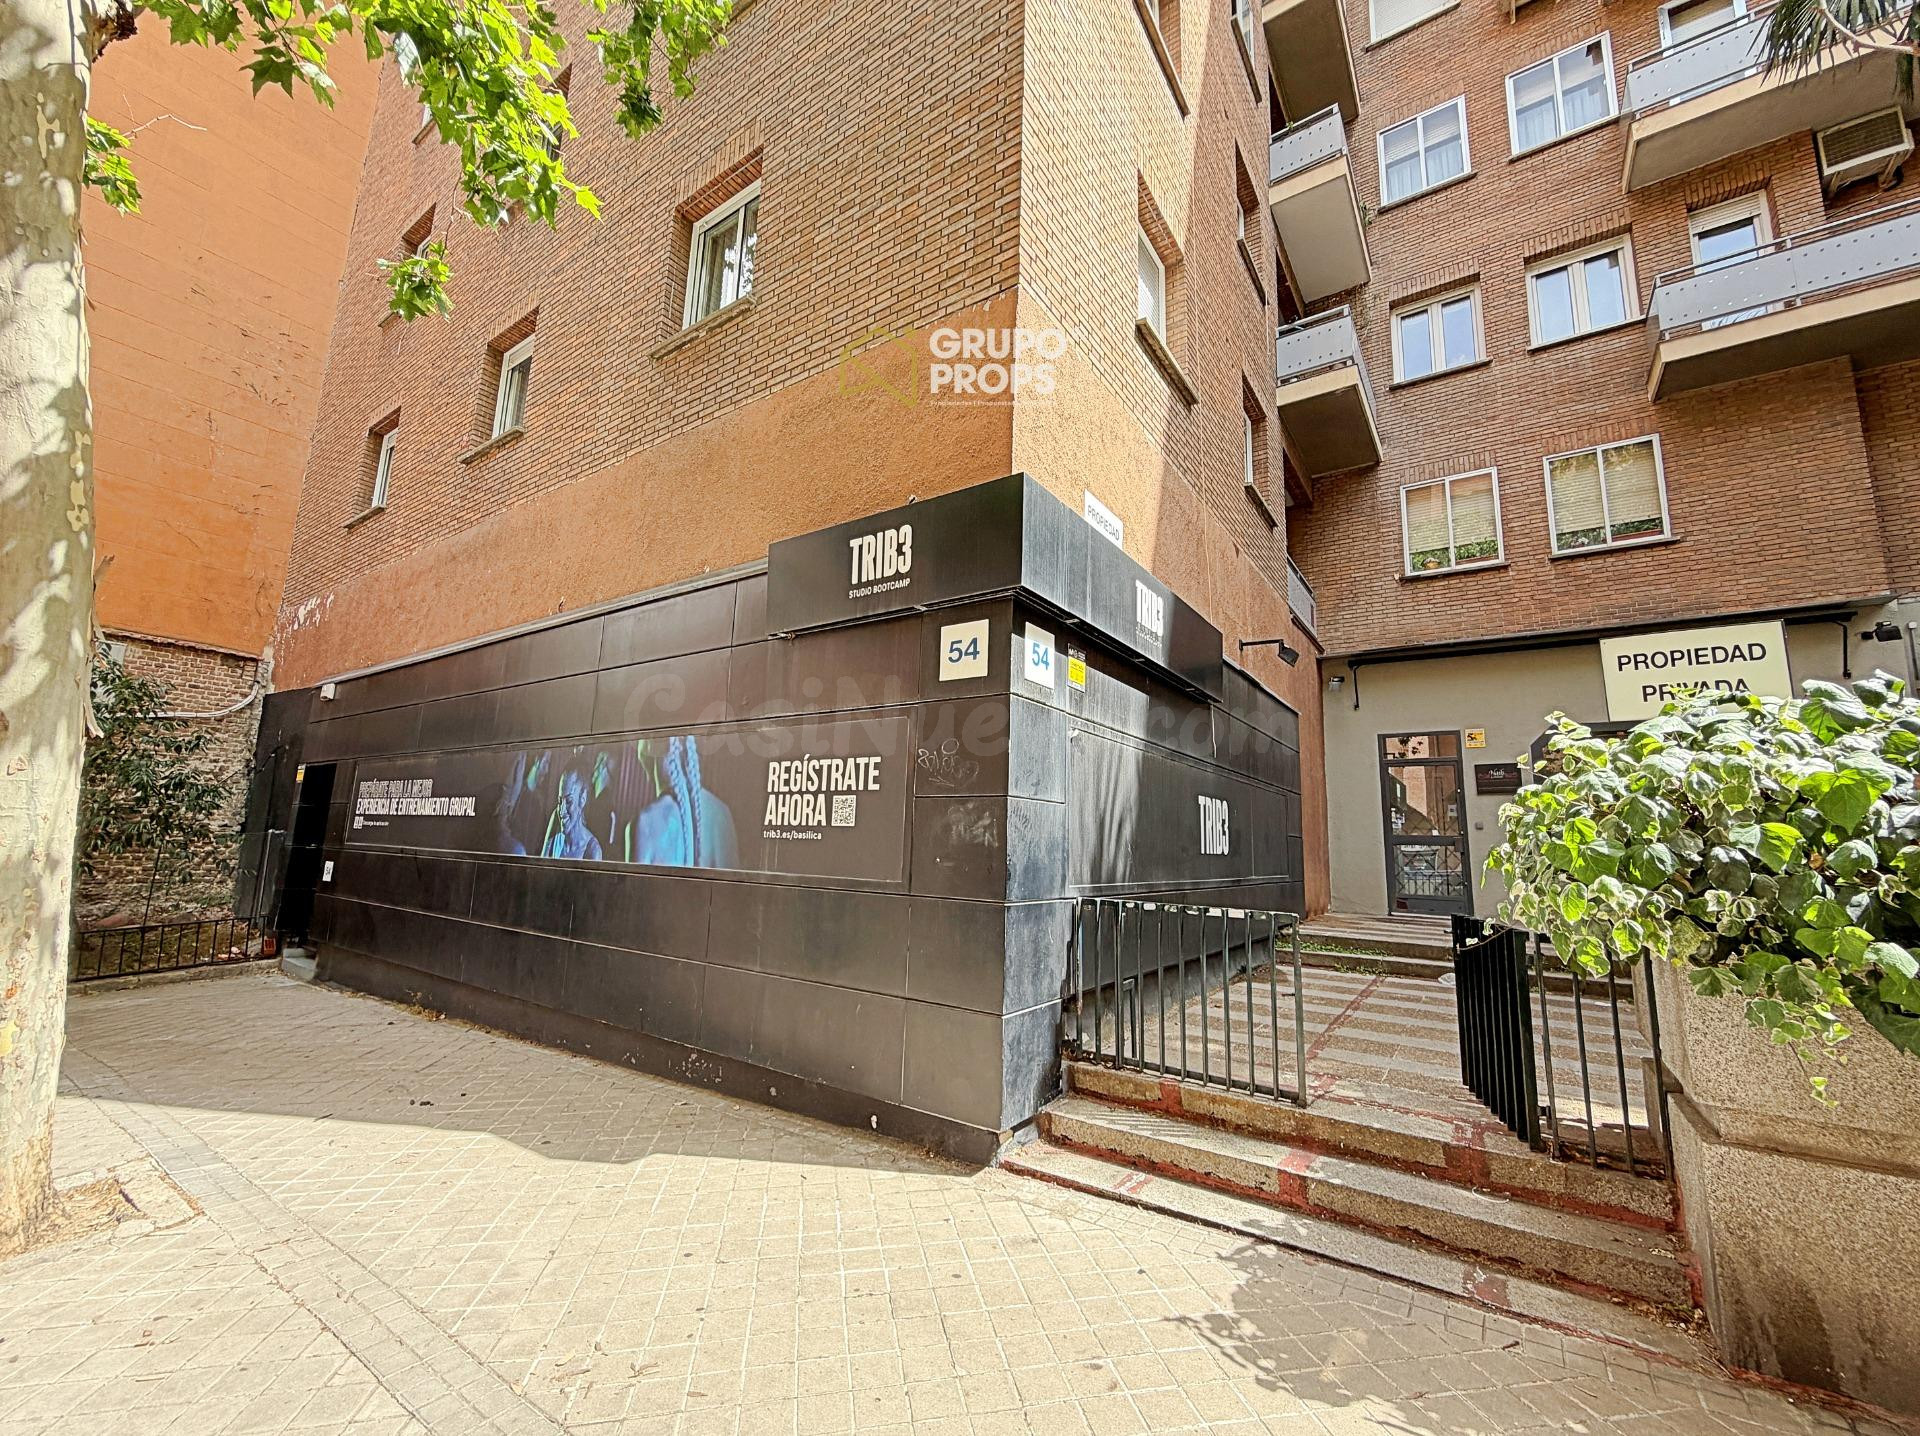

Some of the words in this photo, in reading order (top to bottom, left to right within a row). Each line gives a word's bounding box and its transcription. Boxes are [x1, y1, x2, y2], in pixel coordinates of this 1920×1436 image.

[1087, 504, 1120, 542] PROPIEDAD
[849, 524, 913, 585] TRIB3
[848, 586, 872, 599] STUDIO
[873, 577, 911, 594] BOOTCAMP
[1135, 579, 1164, 637] TRIB3
[948, 637, 980, 663] 54
[1031, 643, 1050, 671] 54
[1617, 642, 1767, 672] PROPIEDAD
[767, 754, 882, 792] REGÍSTRATE
[355, 798, 390, 815] EXPERIENCIA
[389, 798, 399, 815] DE
[398, 797, 450, 816] ENTRENAMIENTO
[448, 796, 476, 817] GRUPAL
[764, 794, 827, 827] AHORA
[763, 829, 822, 841] trib3.es/basilica
[1198, 795, 1230, 856] TRIB3
